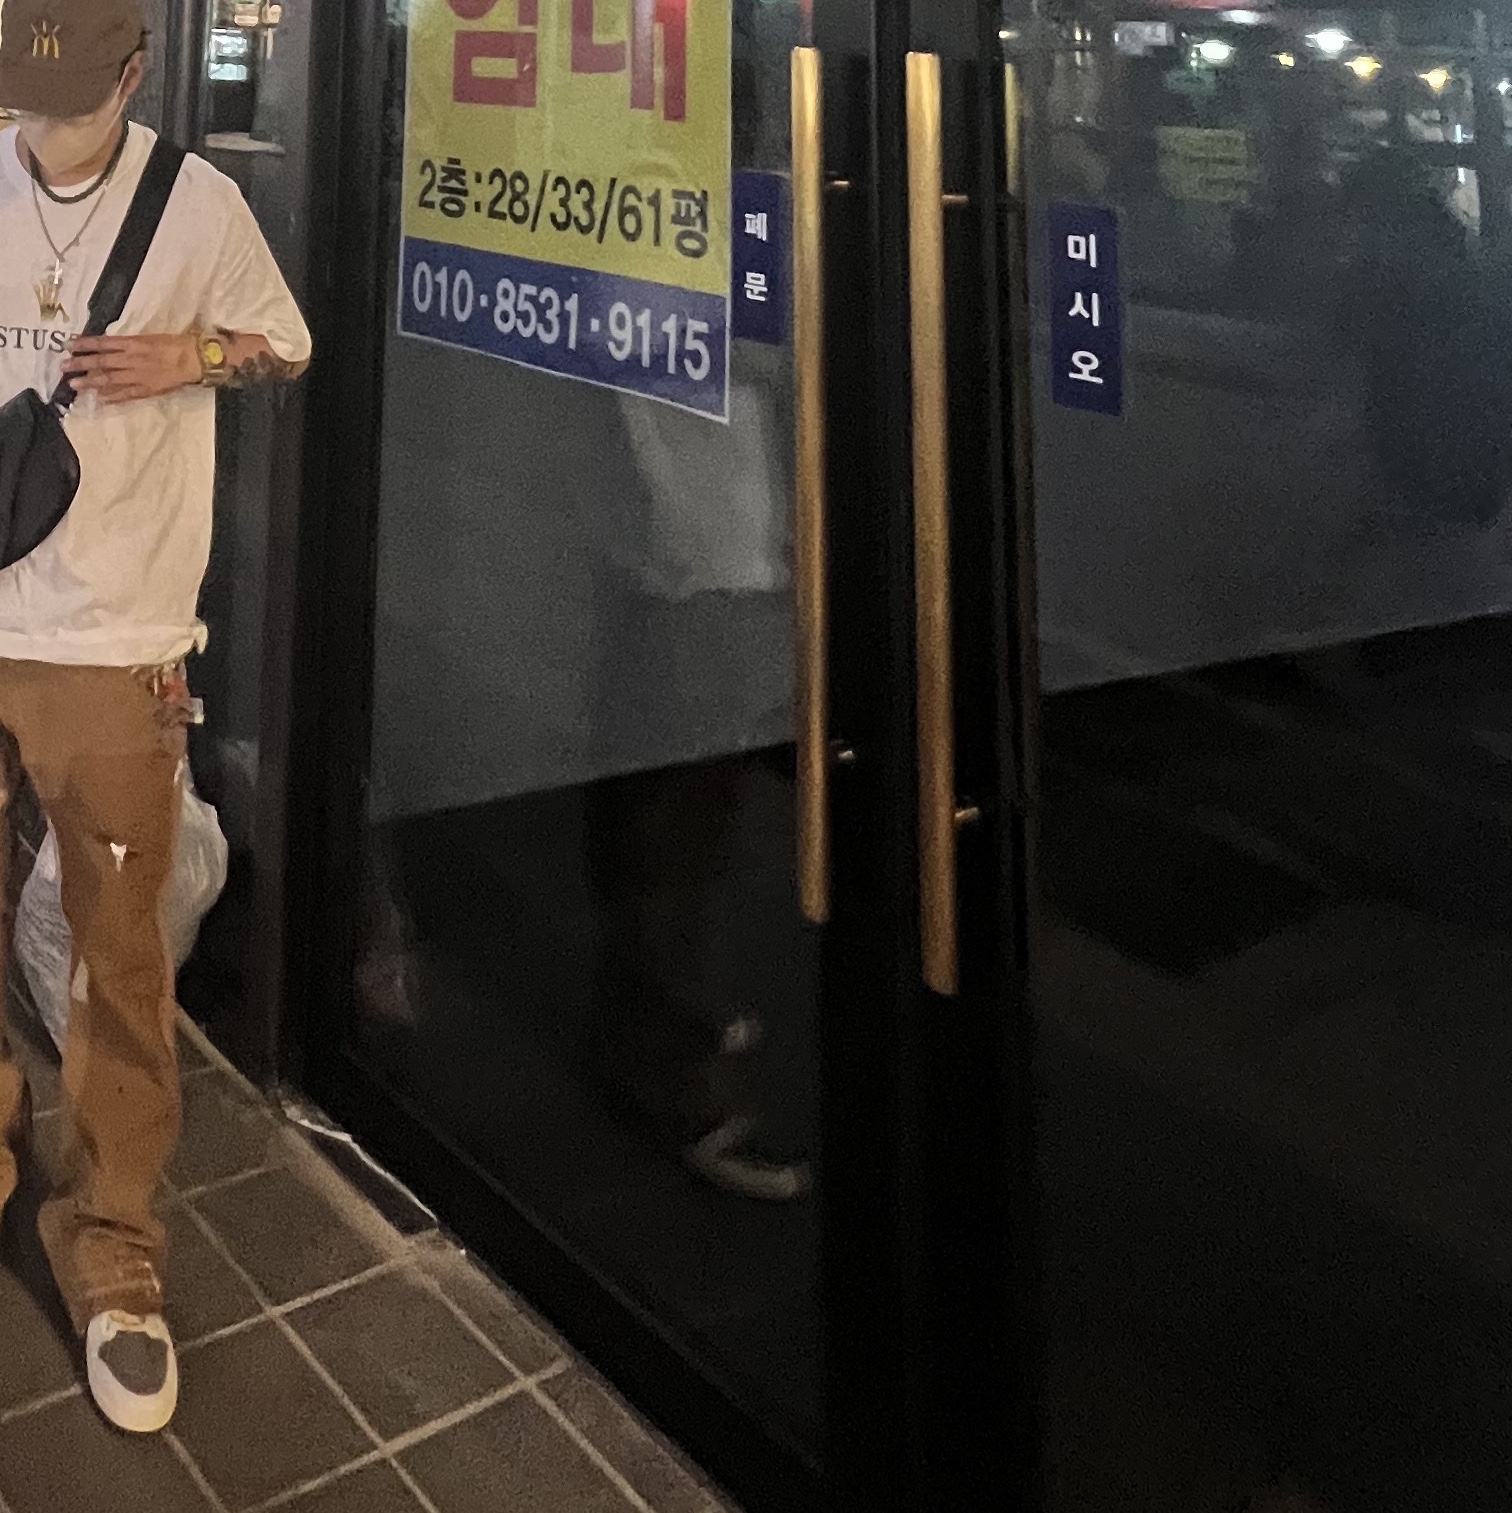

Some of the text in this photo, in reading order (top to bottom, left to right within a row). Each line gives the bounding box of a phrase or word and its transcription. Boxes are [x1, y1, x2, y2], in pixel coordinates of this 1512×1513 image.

[418, 156, 709, 259] 2층:28/33/61평
[743, 212, 768, 302] 폐문
[1066, 233, 1104, 384] 미시오
